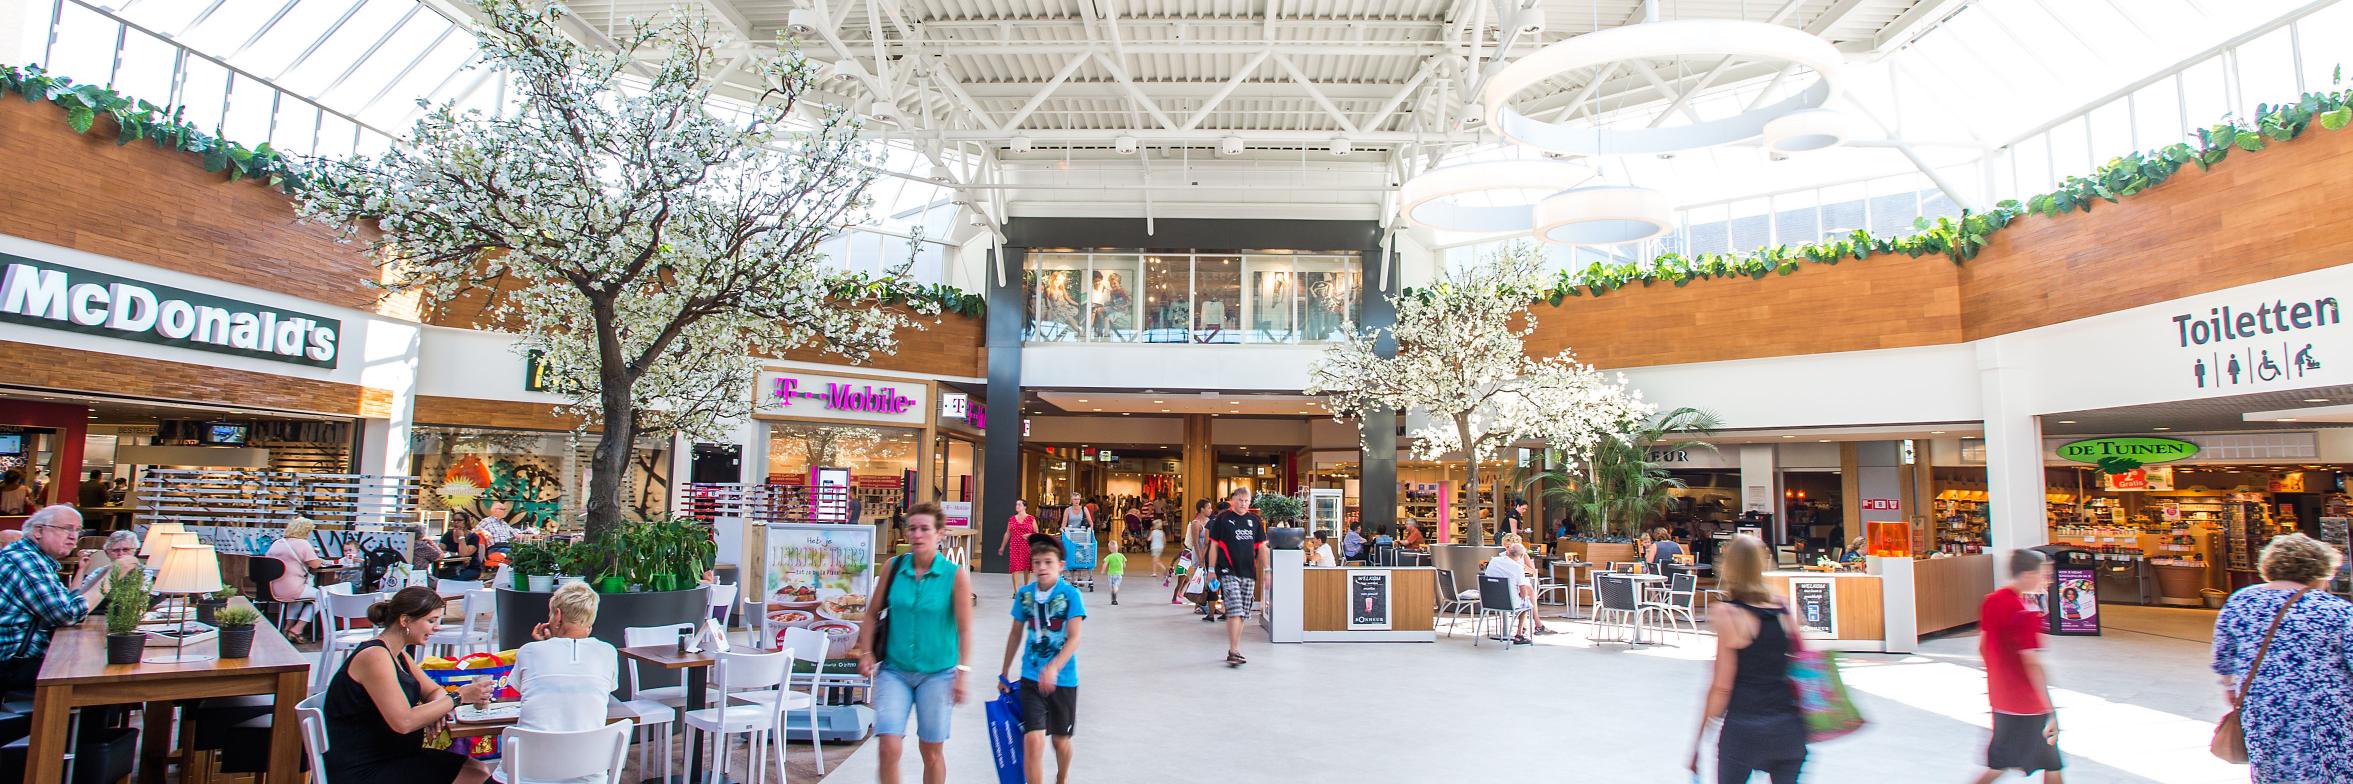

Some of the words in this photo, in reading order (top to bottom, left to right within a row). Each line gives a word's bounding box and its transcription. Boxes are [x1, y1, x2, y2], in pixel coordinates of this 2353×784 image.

[1, 263, 336, 361] McDonald's
[2172, 297, 2340, 347] Toiletten
[1644, 450, 1689, 462] EUR
[2069, 446, 2095, 455] DE
